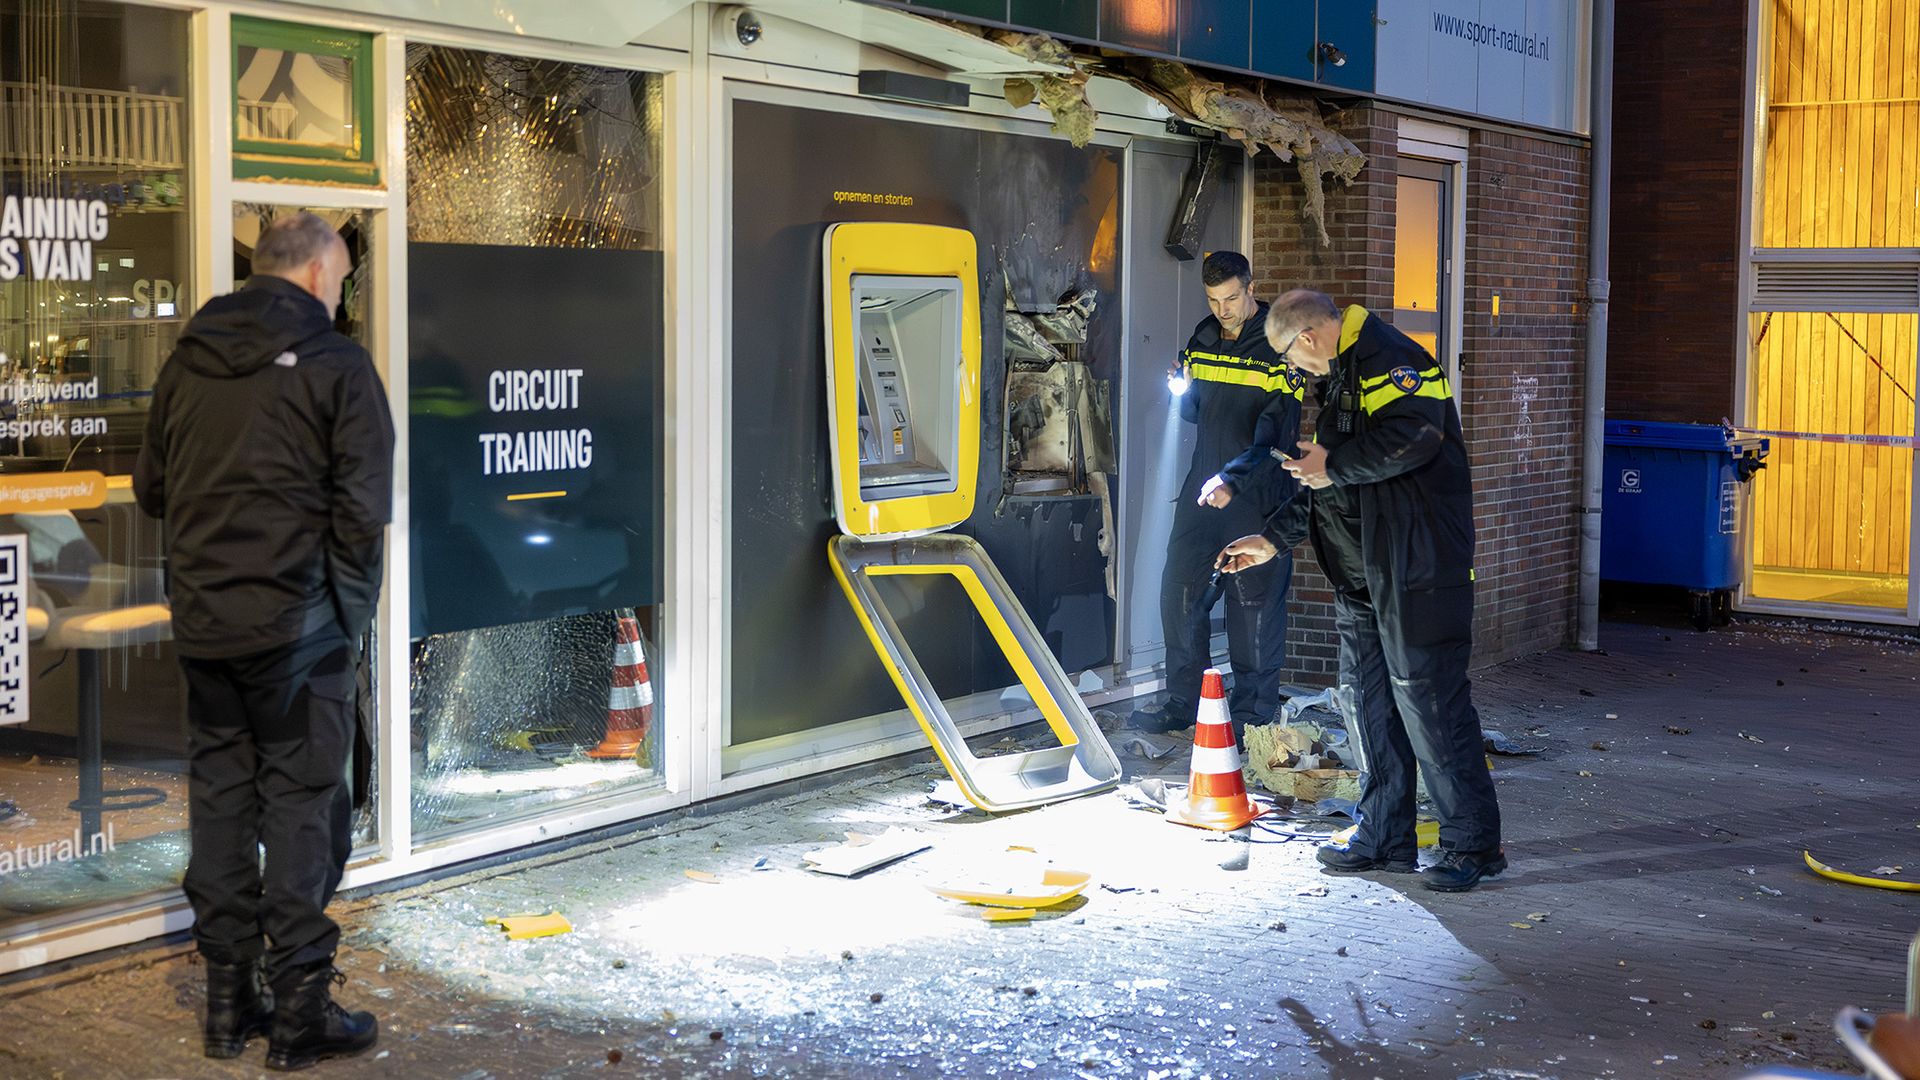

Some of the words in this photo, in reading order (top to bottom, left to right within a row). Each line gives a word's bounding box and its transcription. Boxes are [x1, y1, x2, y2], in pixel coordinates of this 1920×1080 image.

[1433, 11, 1550, 61] www.sport-natural.nl
[0, 195, 109, 241] AINING
[833, 191, 872, 204] opnemen
[873, 194, 884, 204] en
[884, 193, 913, 206] storten
[0, 237, 20, 281] S
[28, 239, 92, 281] VAN
[489, 369, 584, 413] CIRCUIT
[70, 417, 108, 437] aan
[478, 428, 593, 476] TRAINING
[0, 481, 95, 503] kingsgesprek/
[1623, 471, 1639, 486] G
[0, 822, 116, 876] atural.nl
